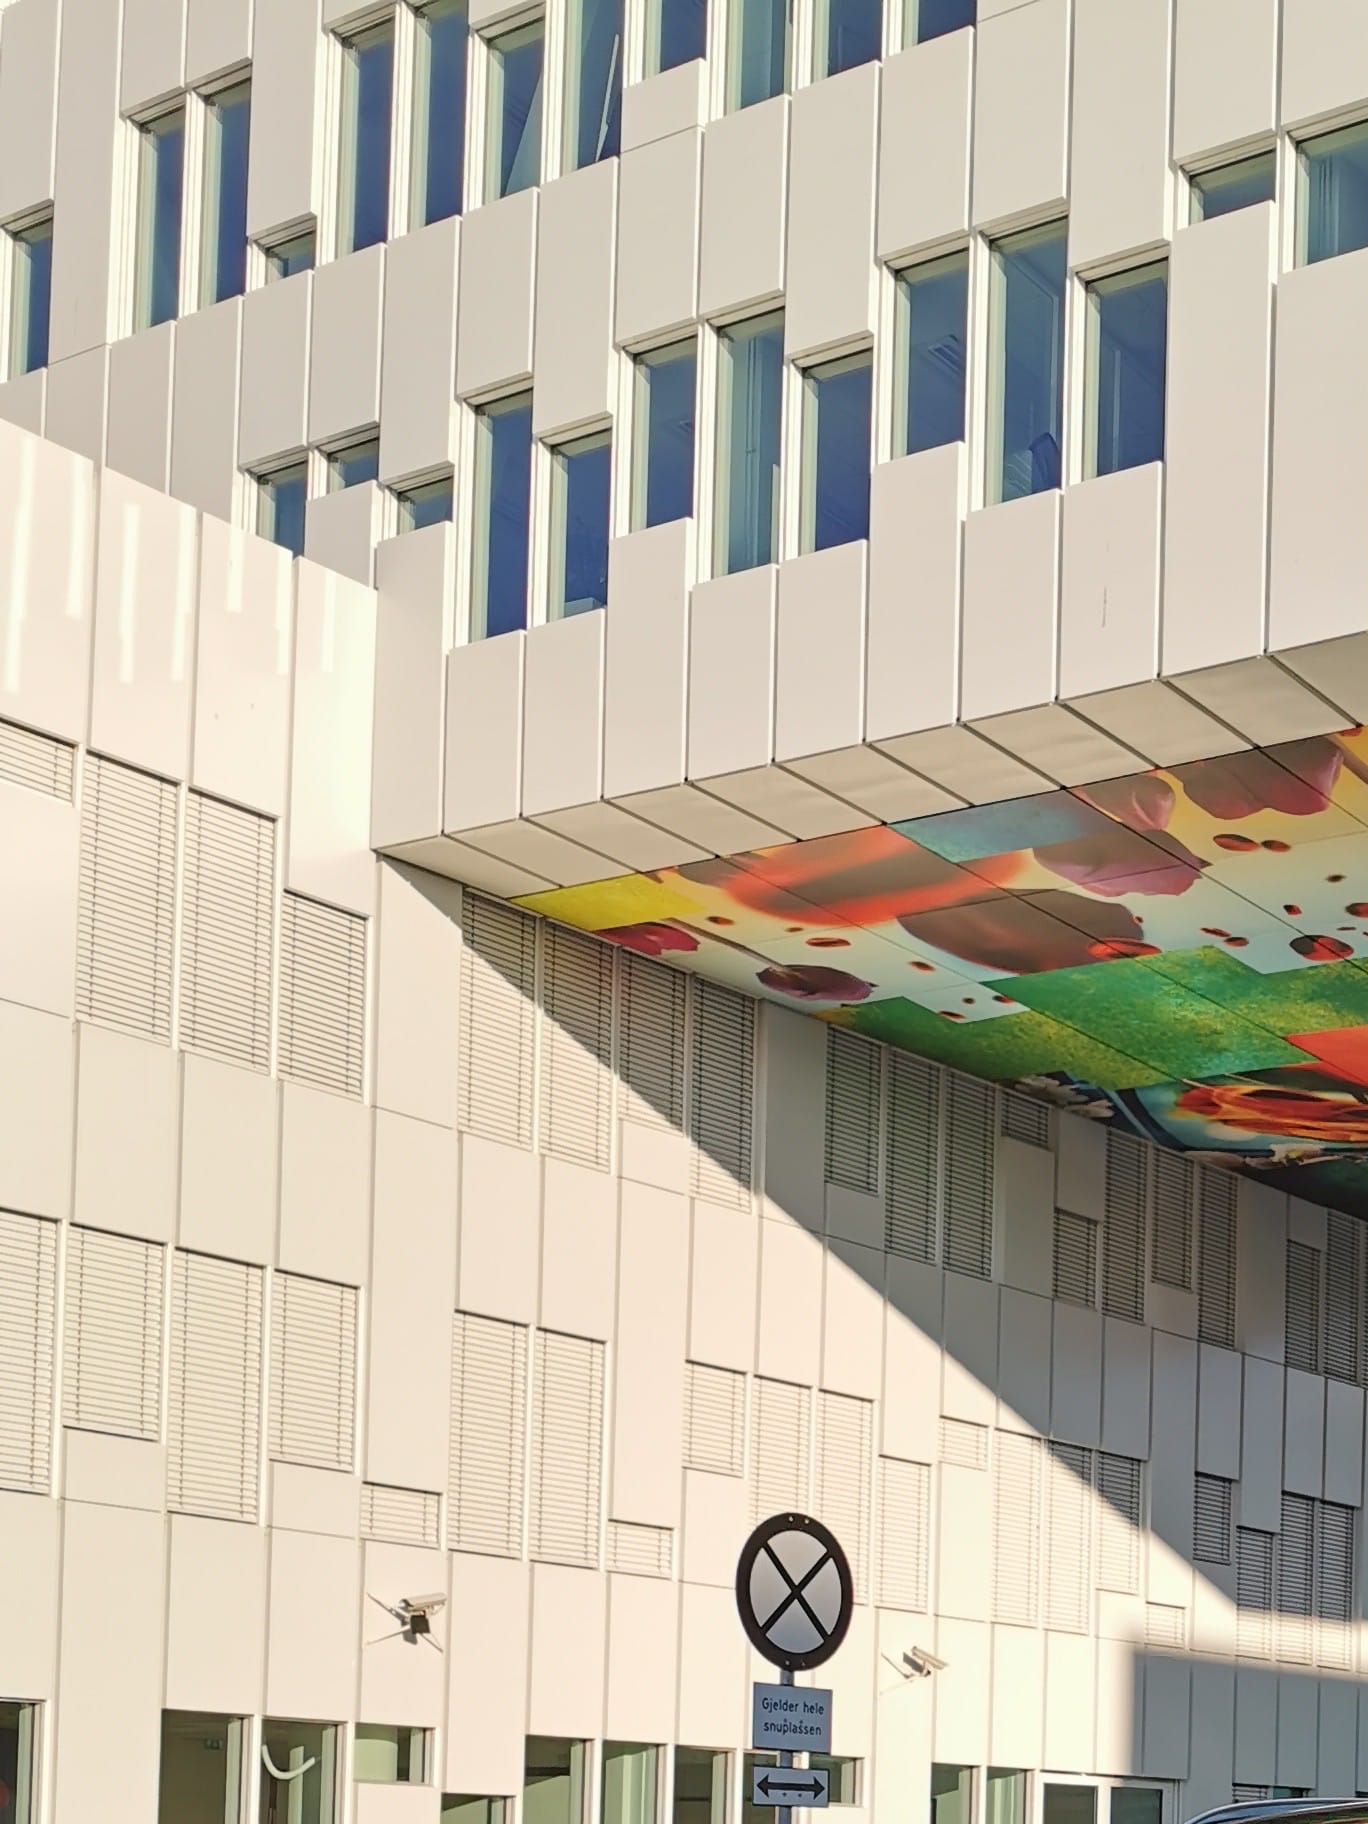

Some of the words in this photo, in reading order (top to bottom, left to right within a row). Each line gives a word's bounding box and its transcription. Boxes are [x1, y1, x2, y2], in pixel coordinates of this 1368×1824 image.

[762, 1697, 799, 1714] Gjelder
[803, 1701, 825, 1715] hele
[763, 1719, 822, 1736] snuplassen
